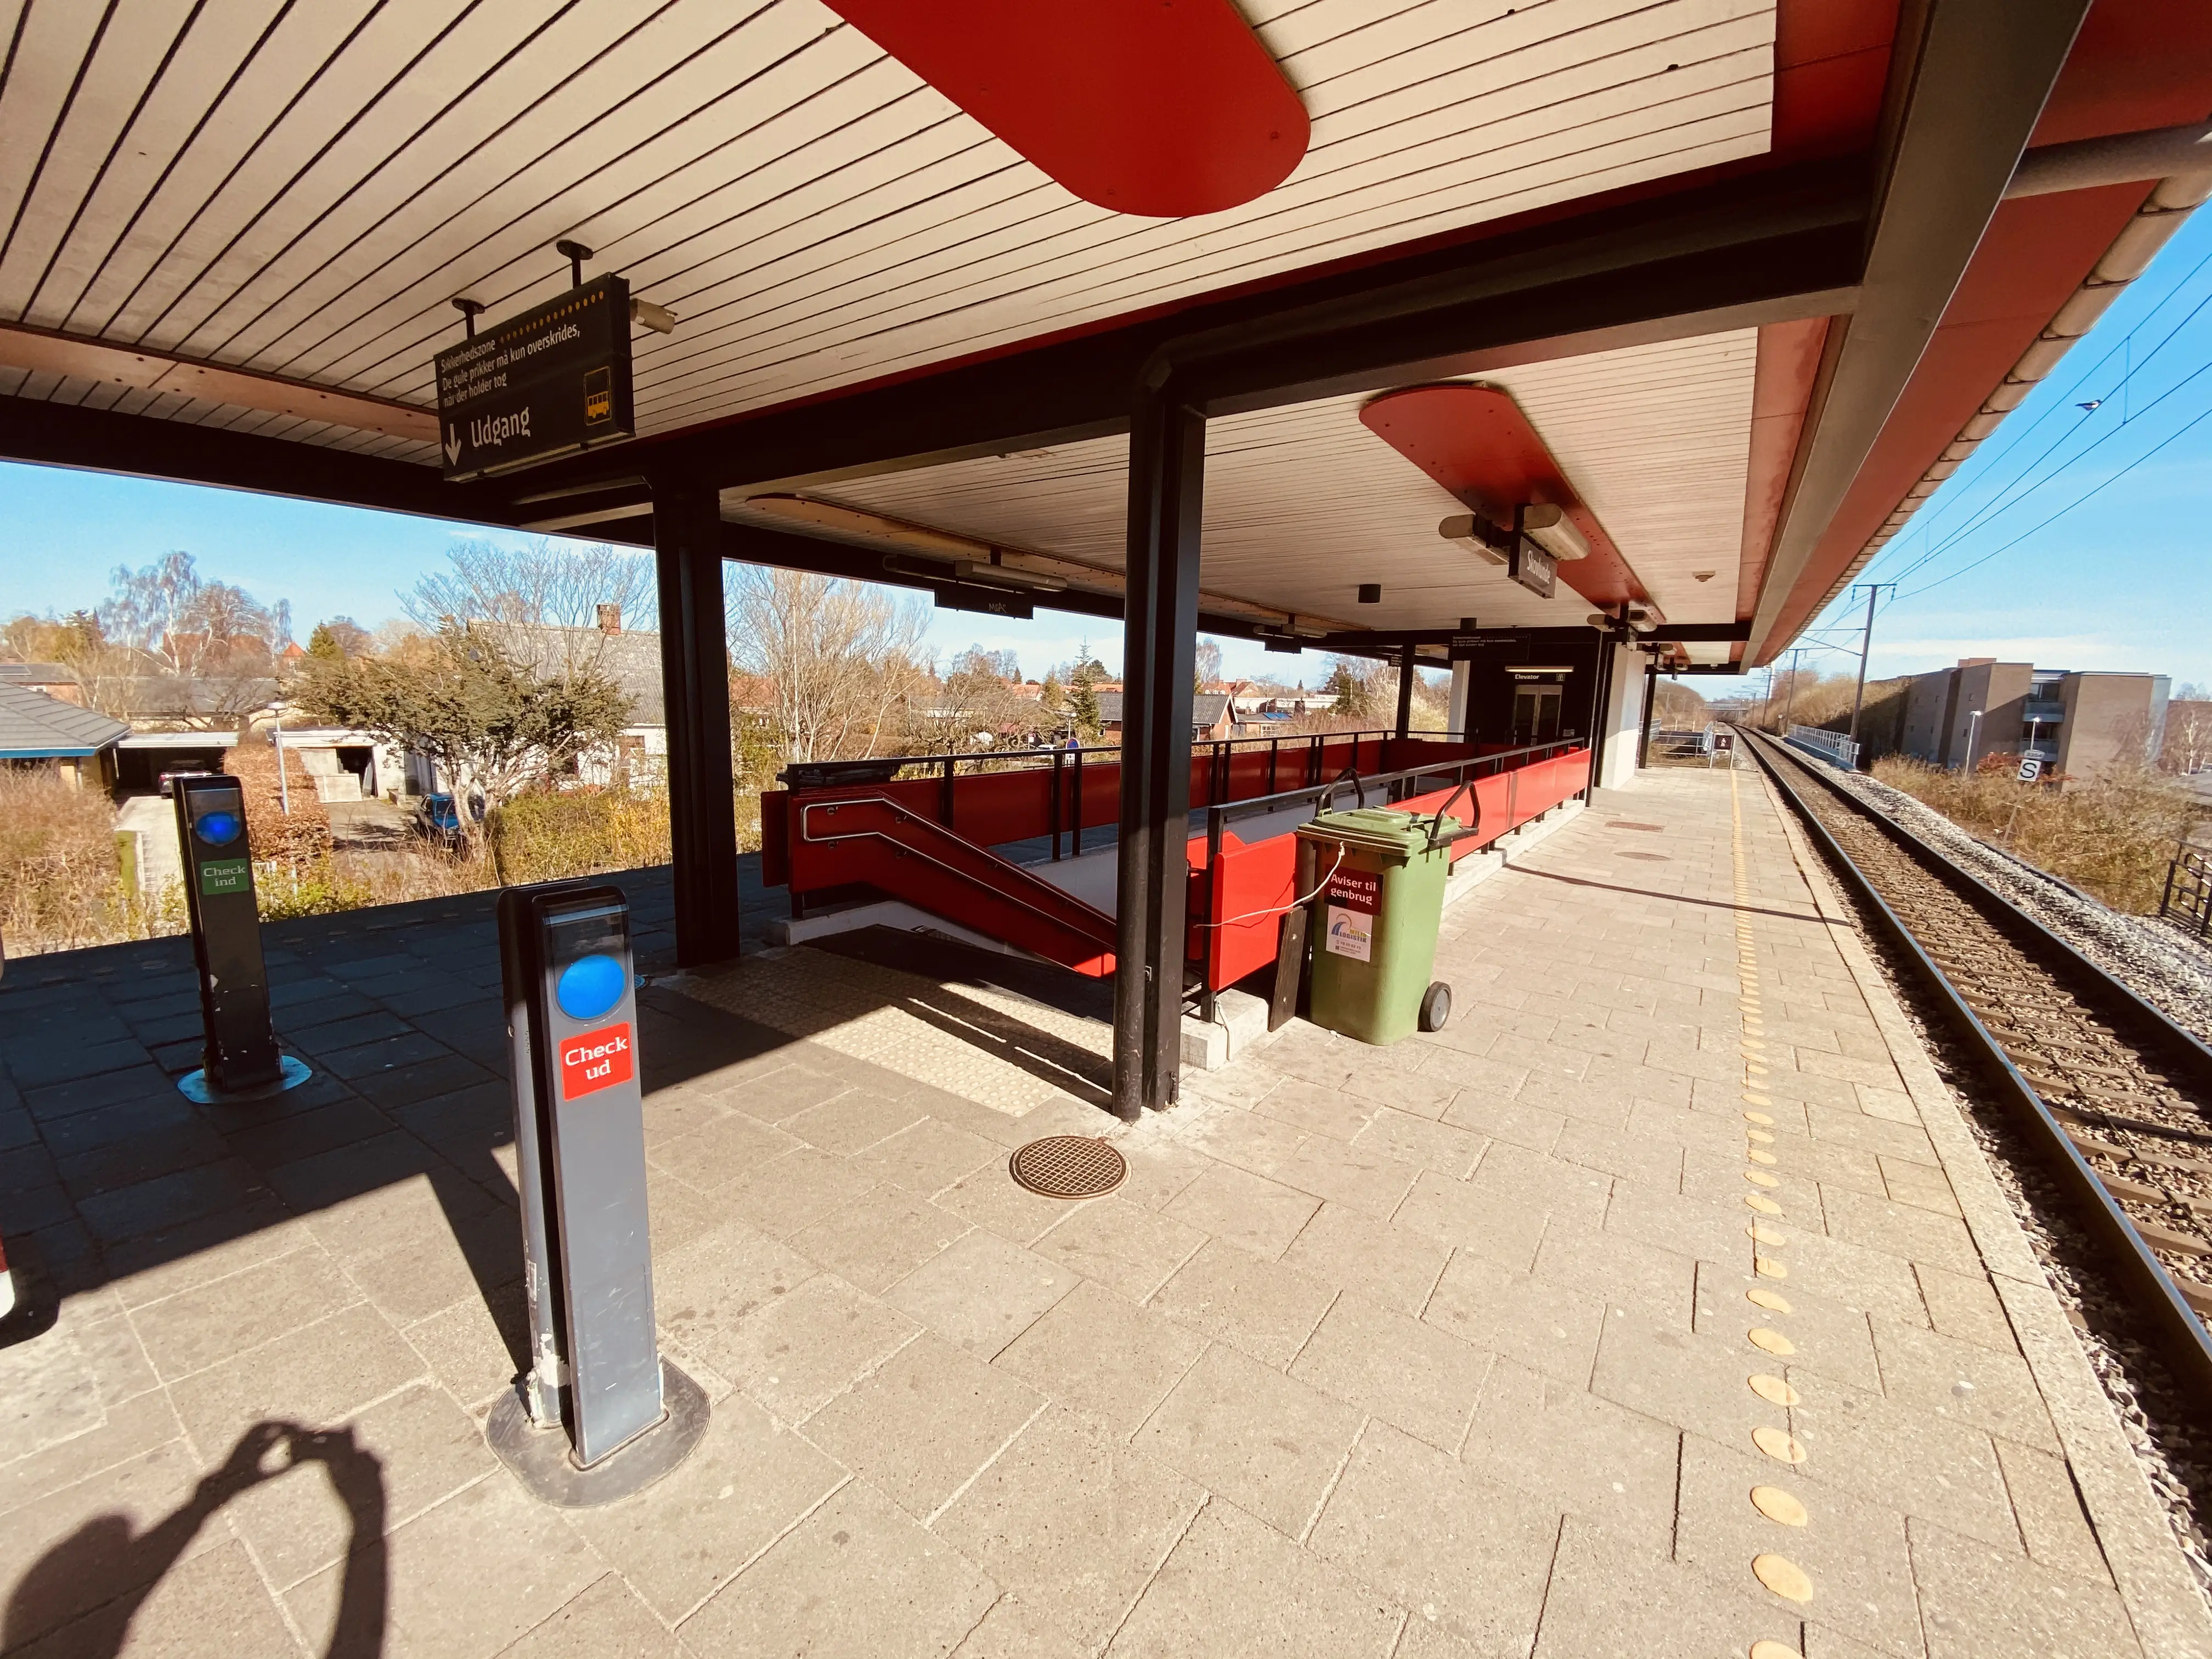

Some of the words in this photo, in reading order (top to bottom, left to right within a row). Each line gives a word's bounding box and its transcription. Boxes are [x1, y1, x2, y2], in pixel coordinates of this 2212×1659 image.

[442, 377, 452, 391] De
[469, 360, 496, 383] prikker
[496, 349, 509, 368] må
[510, 346, 526, 363] kun
[527, 323, 580, 356] overskrides,
[456, 388, 467, 403] der
[469, 379, 492, 398] holder
[494, 372, 507, 388] tog
[471, 407, 531, 448] Udgang
[2019, 763, 2037, 778] S
[203, 865, 246, 877] Check
[215, 877, 237, 887] ind
[1330, 873, 1363, 889] Aviser
[1365, 881, 1376, 892] til
[1330, 888, 1373, 906] genbrug
[1339, 932, 1367, 943] LOGISTIK
[565, 1036, 629, 1066] Check
[586, 1059, 612, 1081] ud
